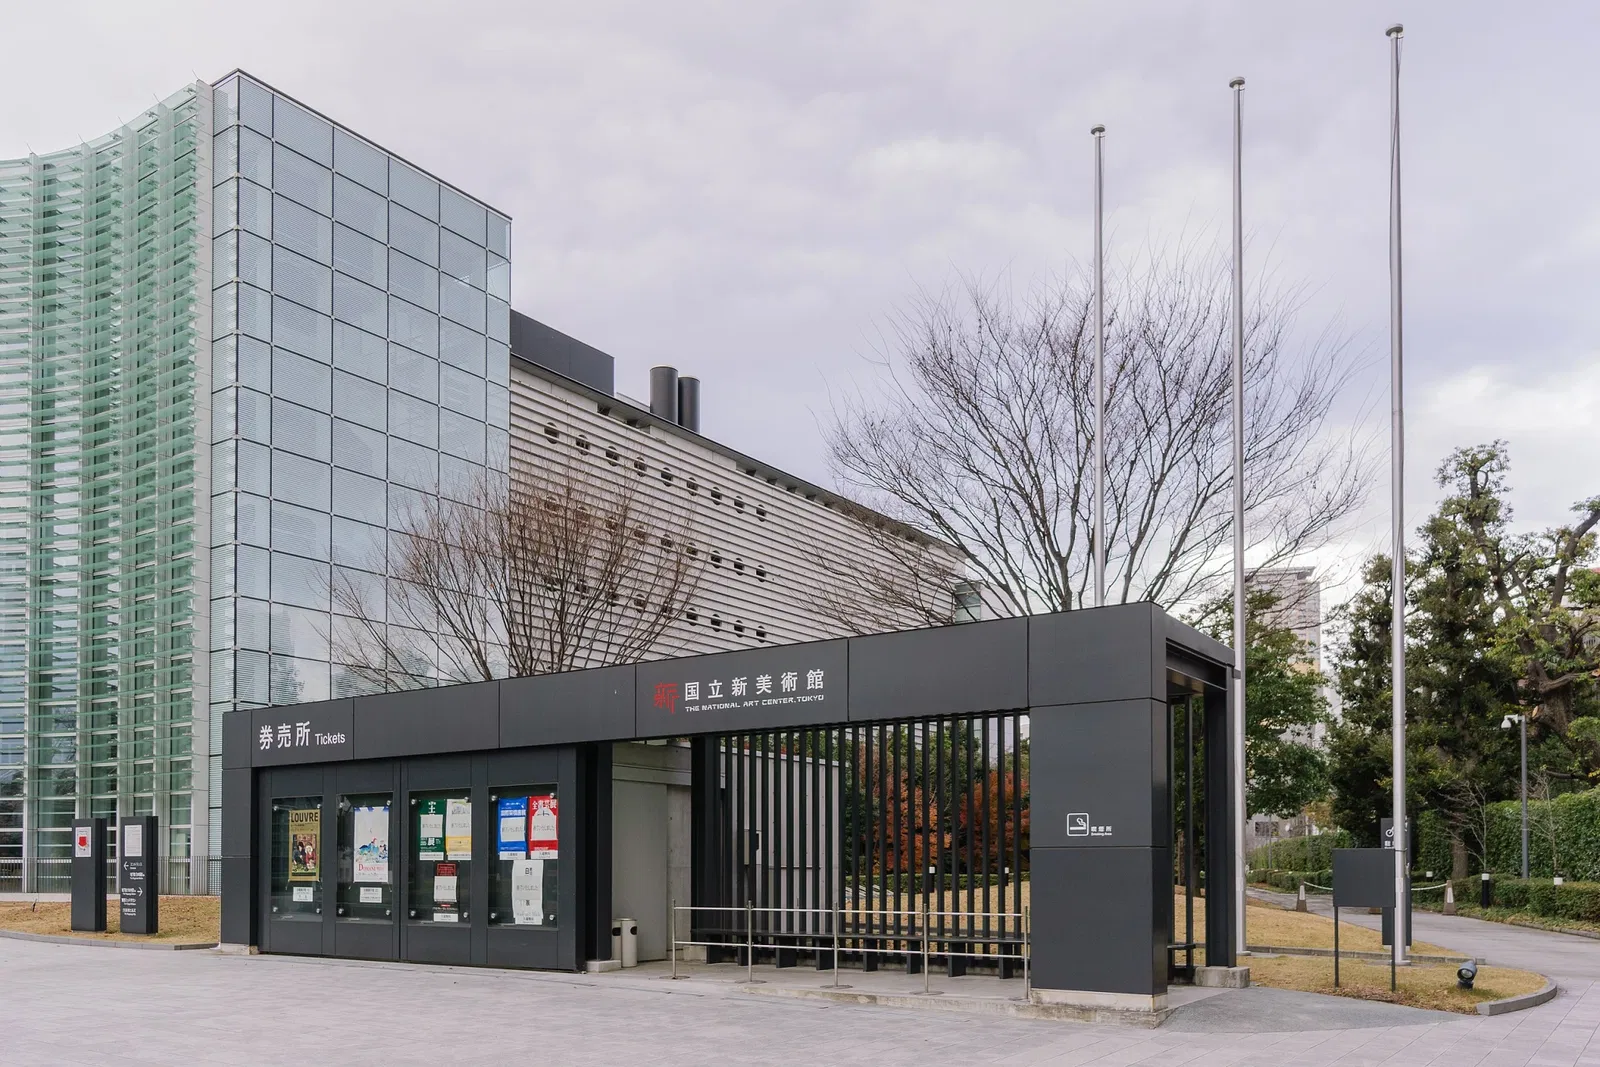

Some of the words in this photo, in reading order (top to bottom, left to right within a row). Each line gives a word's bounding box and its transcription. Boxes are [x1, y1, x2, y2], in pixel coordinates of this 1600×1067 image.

[685, 668, 824, 702] 国立新美術館
[701, 702, 740, 711] NATIONAL
[743, 700, 760, 708] ART
[259, 720, 311, 750] 券売所
[315, 732, 346, 746] Tickets
[291, 812, 319, 823] LOUVRE
